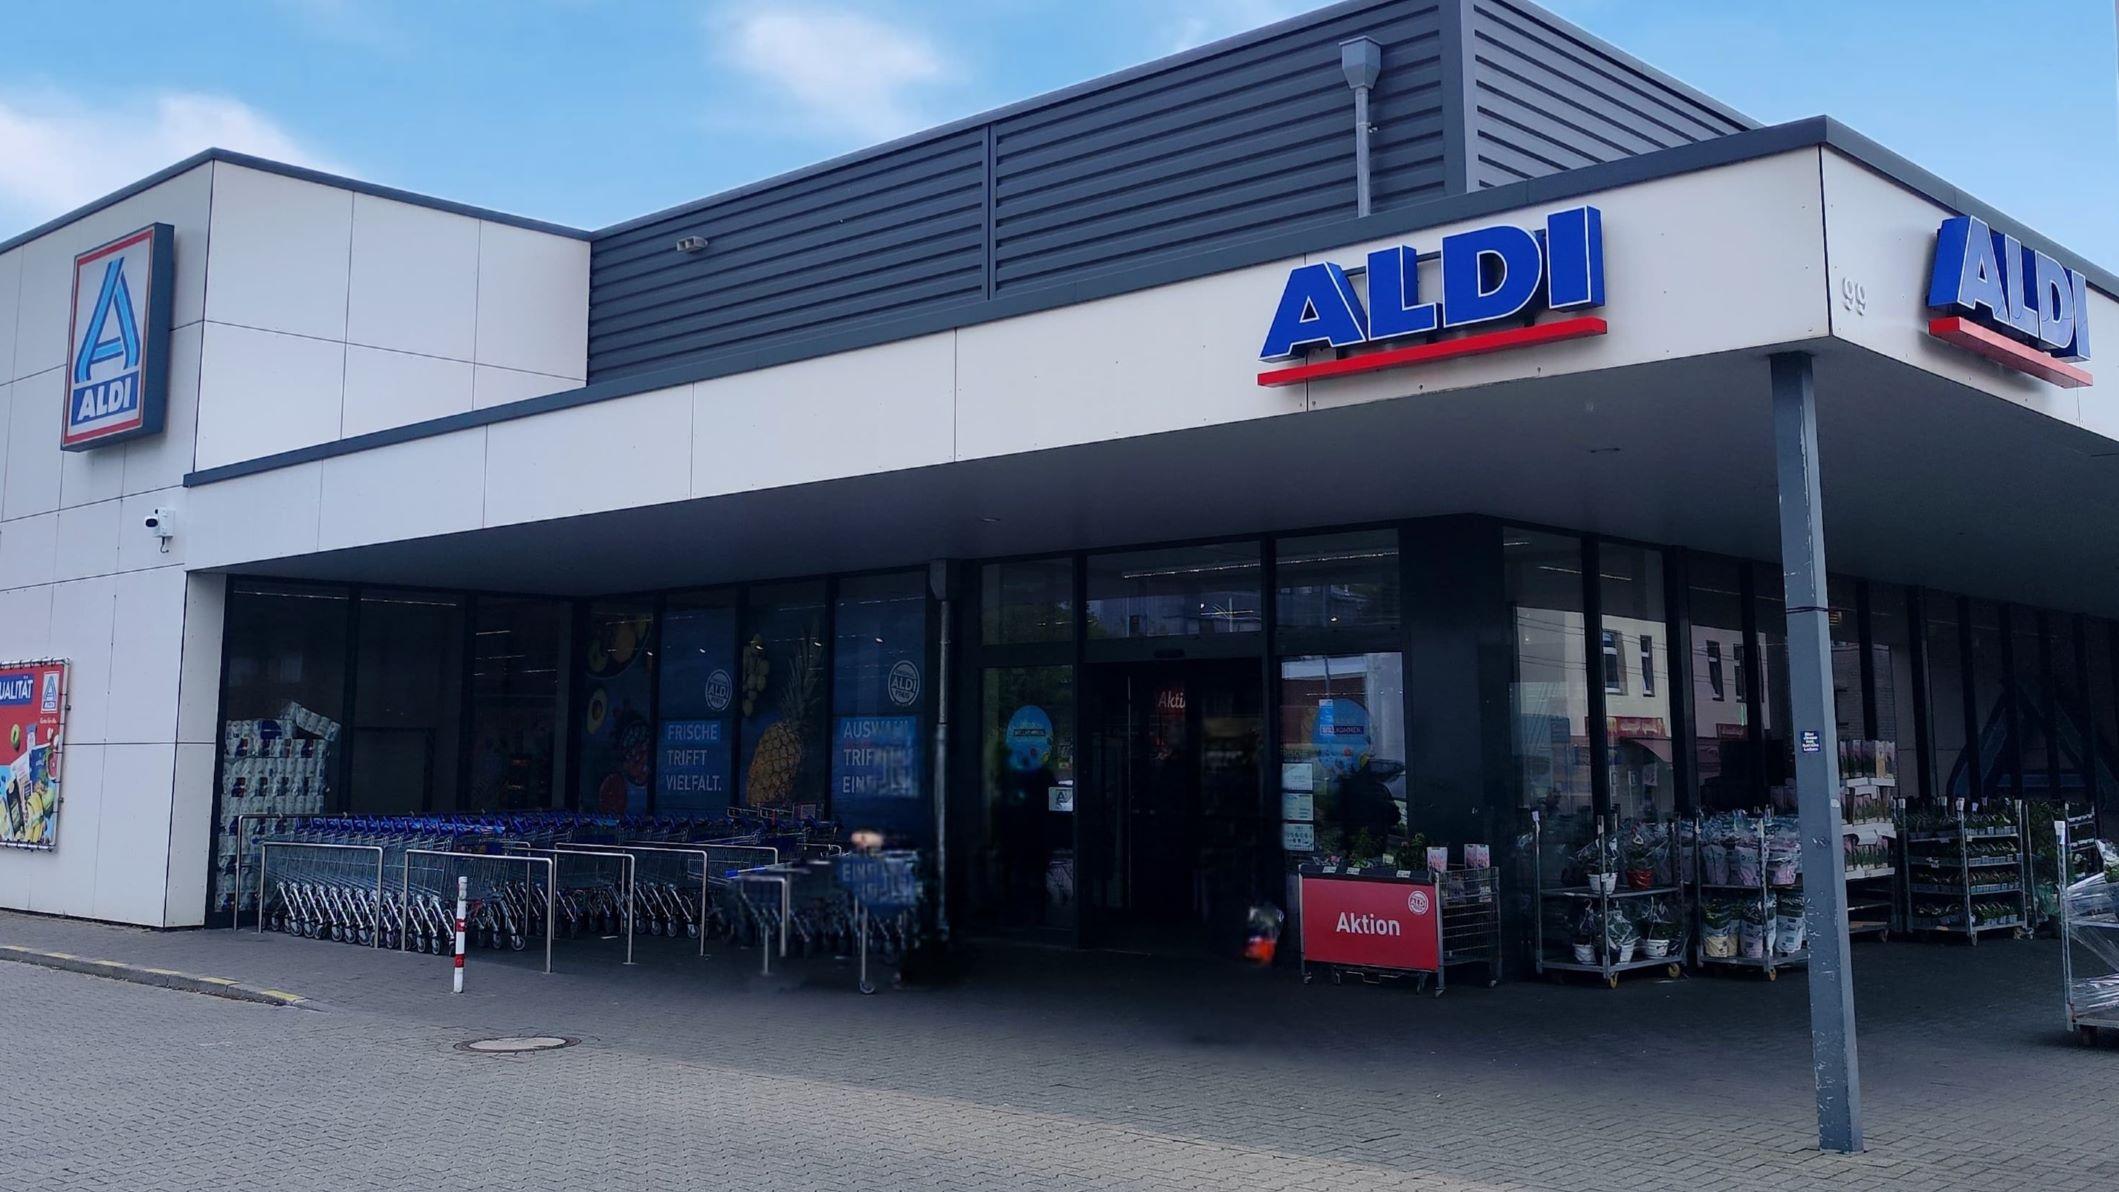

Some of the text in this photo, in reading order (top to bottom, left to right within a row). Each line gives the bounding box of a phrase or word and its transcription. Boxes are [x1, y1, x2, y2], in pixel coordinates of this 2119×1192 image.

[1259, 205, 1606, 362] ALDI
[1927, 215, 2091, 363] ALDI
[77, 376, 131, 422] ALDI
[0, 674, 34, 700] UALITÄT
[891, 675, 917, 692] ALDI
[1158, 690, 1186, 709] Akti
[667, 724, 718, 740] FRISCHE
[667, 749, 708, 766] TRIFFT
[666, 774, 722, 792] VIELFALT.
[1336, 911, 1400, 936] Aktion
